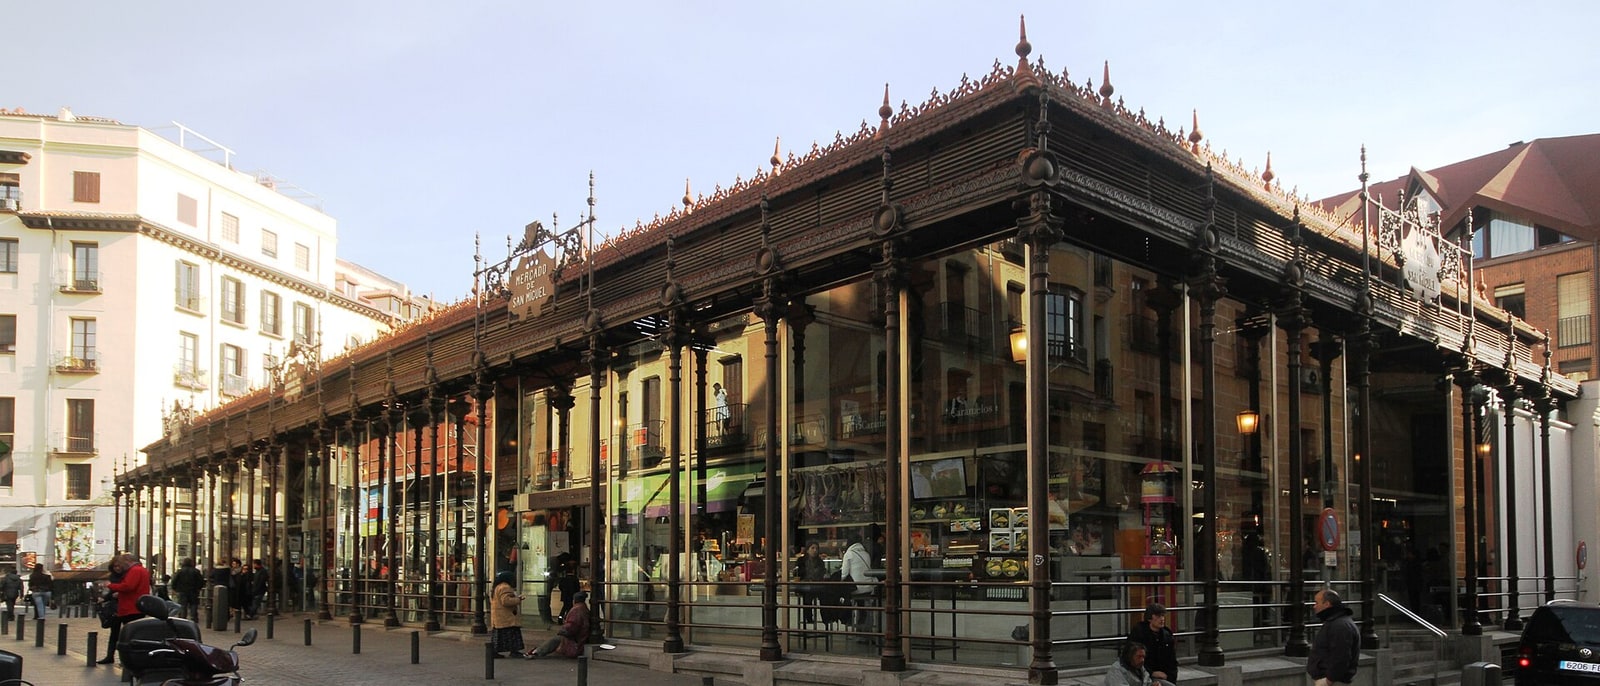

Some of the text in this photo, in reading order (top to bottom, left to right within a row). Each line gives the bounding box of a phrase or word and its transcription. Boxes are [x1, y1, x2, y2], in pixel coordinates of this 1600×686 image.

[515, 264, 547, 286] MERCADO
[527, 281, 535, 290] DE
[513, 286, 547, 308] SAN MIGUEL
[1566, 662, 1588, 670] 6206
